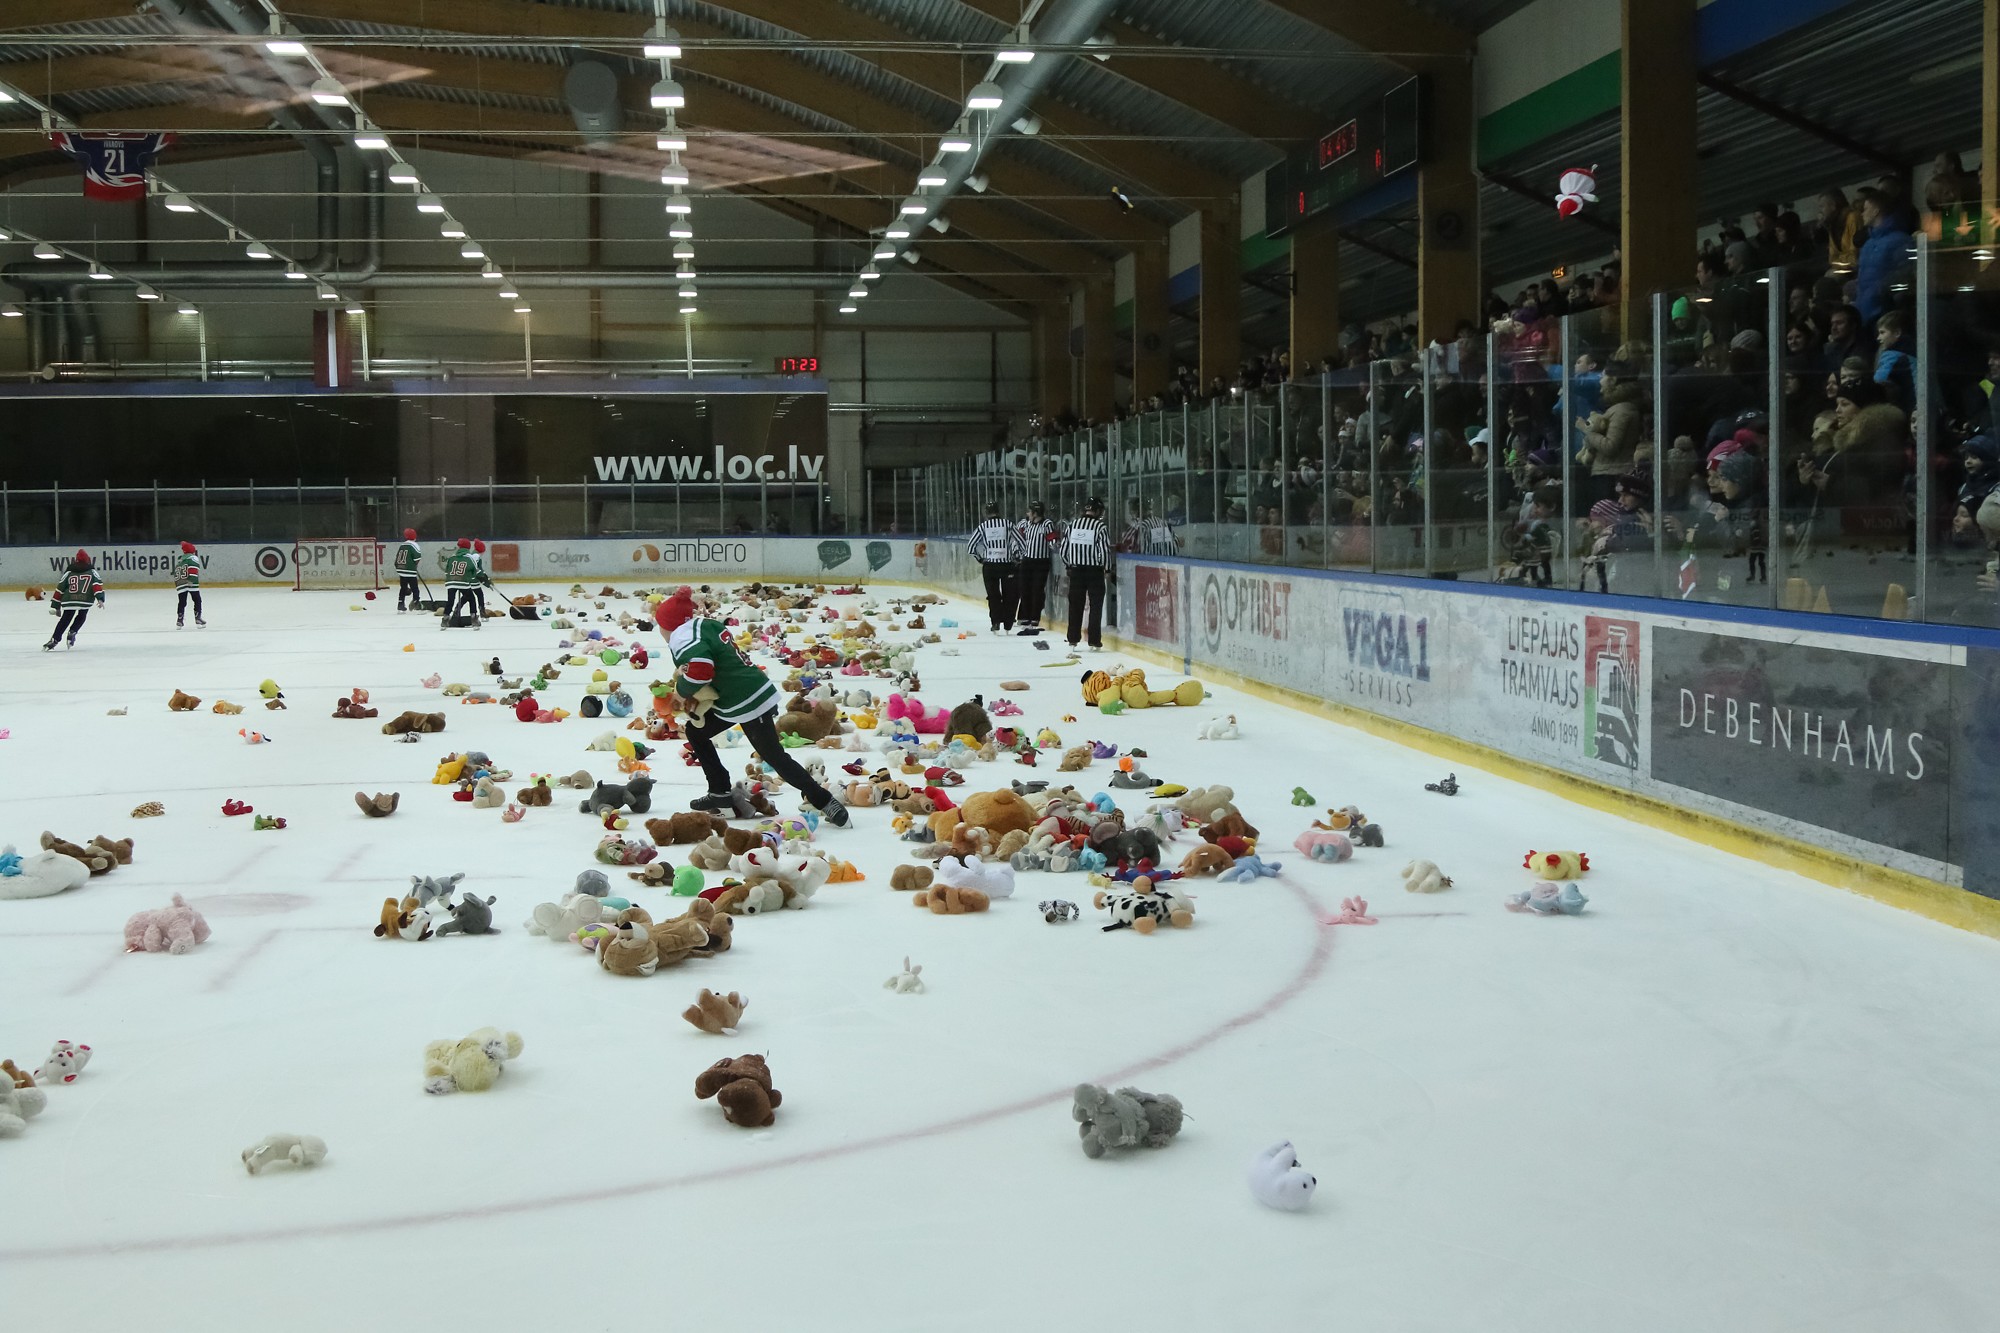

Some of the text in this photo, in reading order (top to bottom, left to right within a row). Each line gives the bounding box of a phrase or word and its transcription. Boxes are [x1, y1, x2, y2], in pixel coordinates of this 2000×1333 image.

[104, 149, 125, 173] 21
[781, 358, 818, 372] 17:23
[593, 444, 825, 481] www.loc.lv
[50, 550, 210, 576] w.hkliepajv
[663, 540, 746, 563] ambero
[174, 564, 189, 582] 33
[449, 560, 468, 576] 19
[67, 575, 93, 595] 87
[1225, 574, 1292, 641] OPTIBET
[1508, 612, 1580, 661] LIEPĀJAS
[1348, 670, 1413, 708] SERVISS
[1500, 657, 1580, 709] TRAMVAJS
[1531, 715, 1579, 748] ANNO 1899
[1679, 687, 1926, 781] DEBENHAMS
